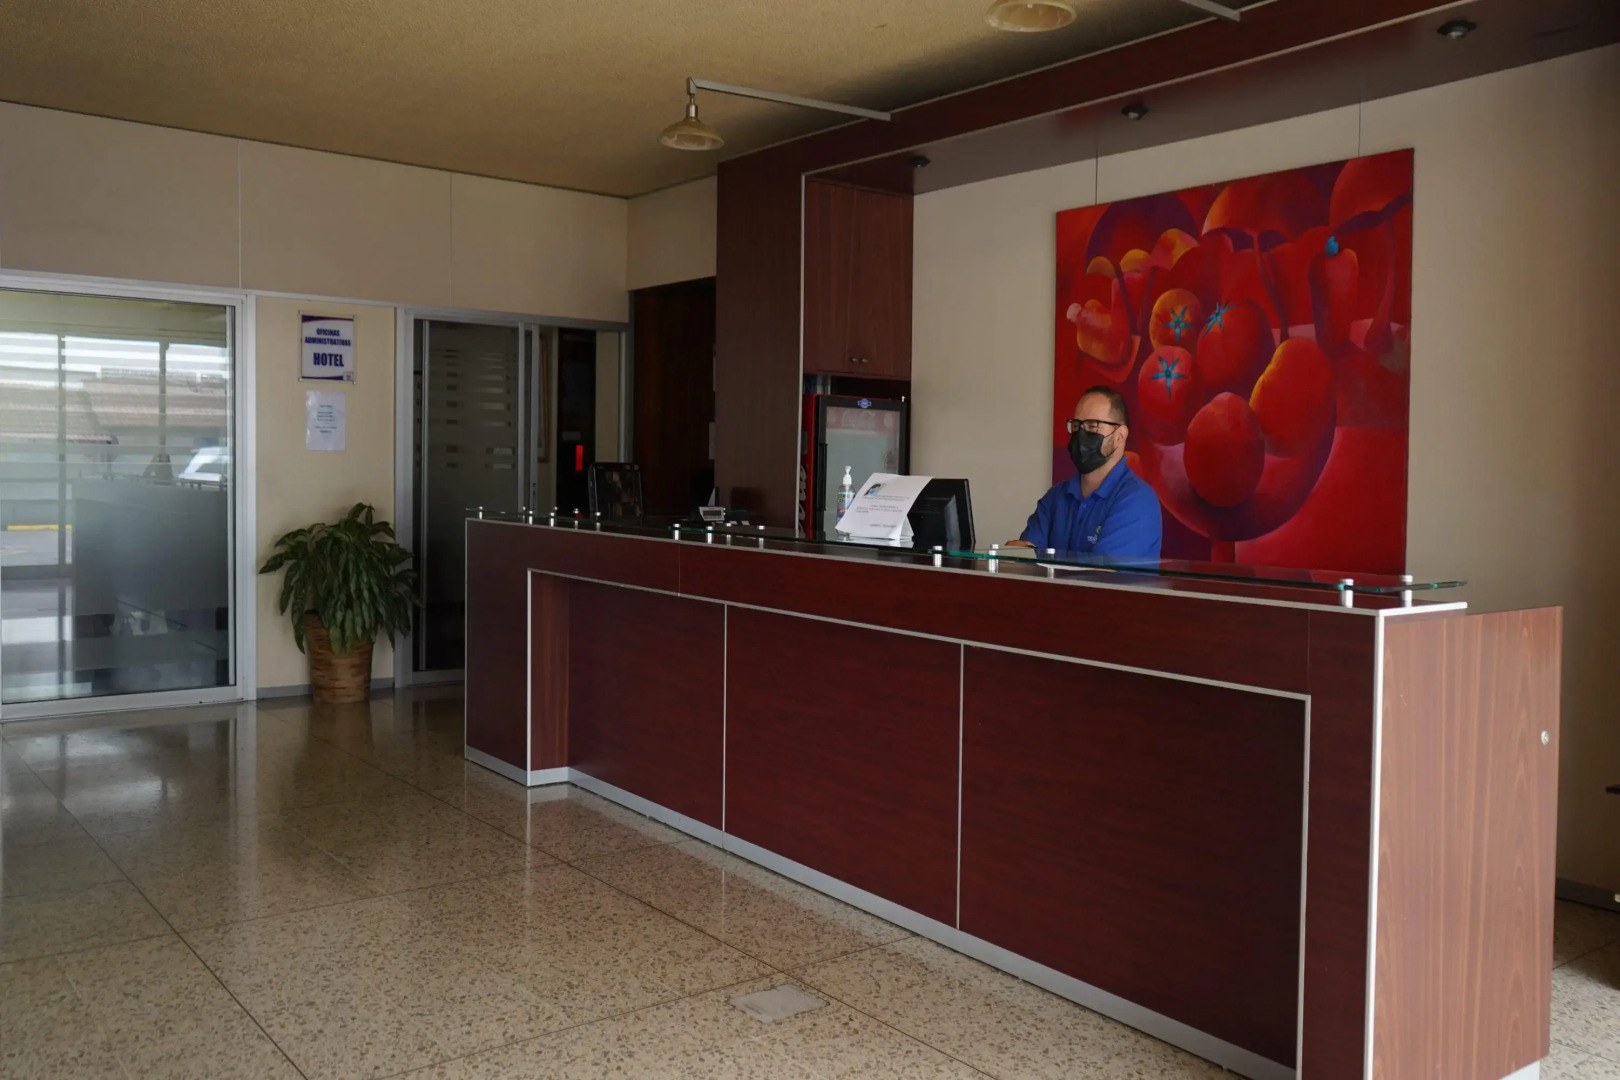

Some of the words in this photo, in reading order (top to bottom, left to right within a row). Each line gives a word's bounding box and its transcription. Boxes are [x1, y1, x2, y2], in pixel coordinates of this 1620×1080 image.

[316, 328, 340, 337] OFICINAS
[305, 336, 351, 347] ADMINISTRATIVAS
[313, 352, 344, 367] HOTEL
